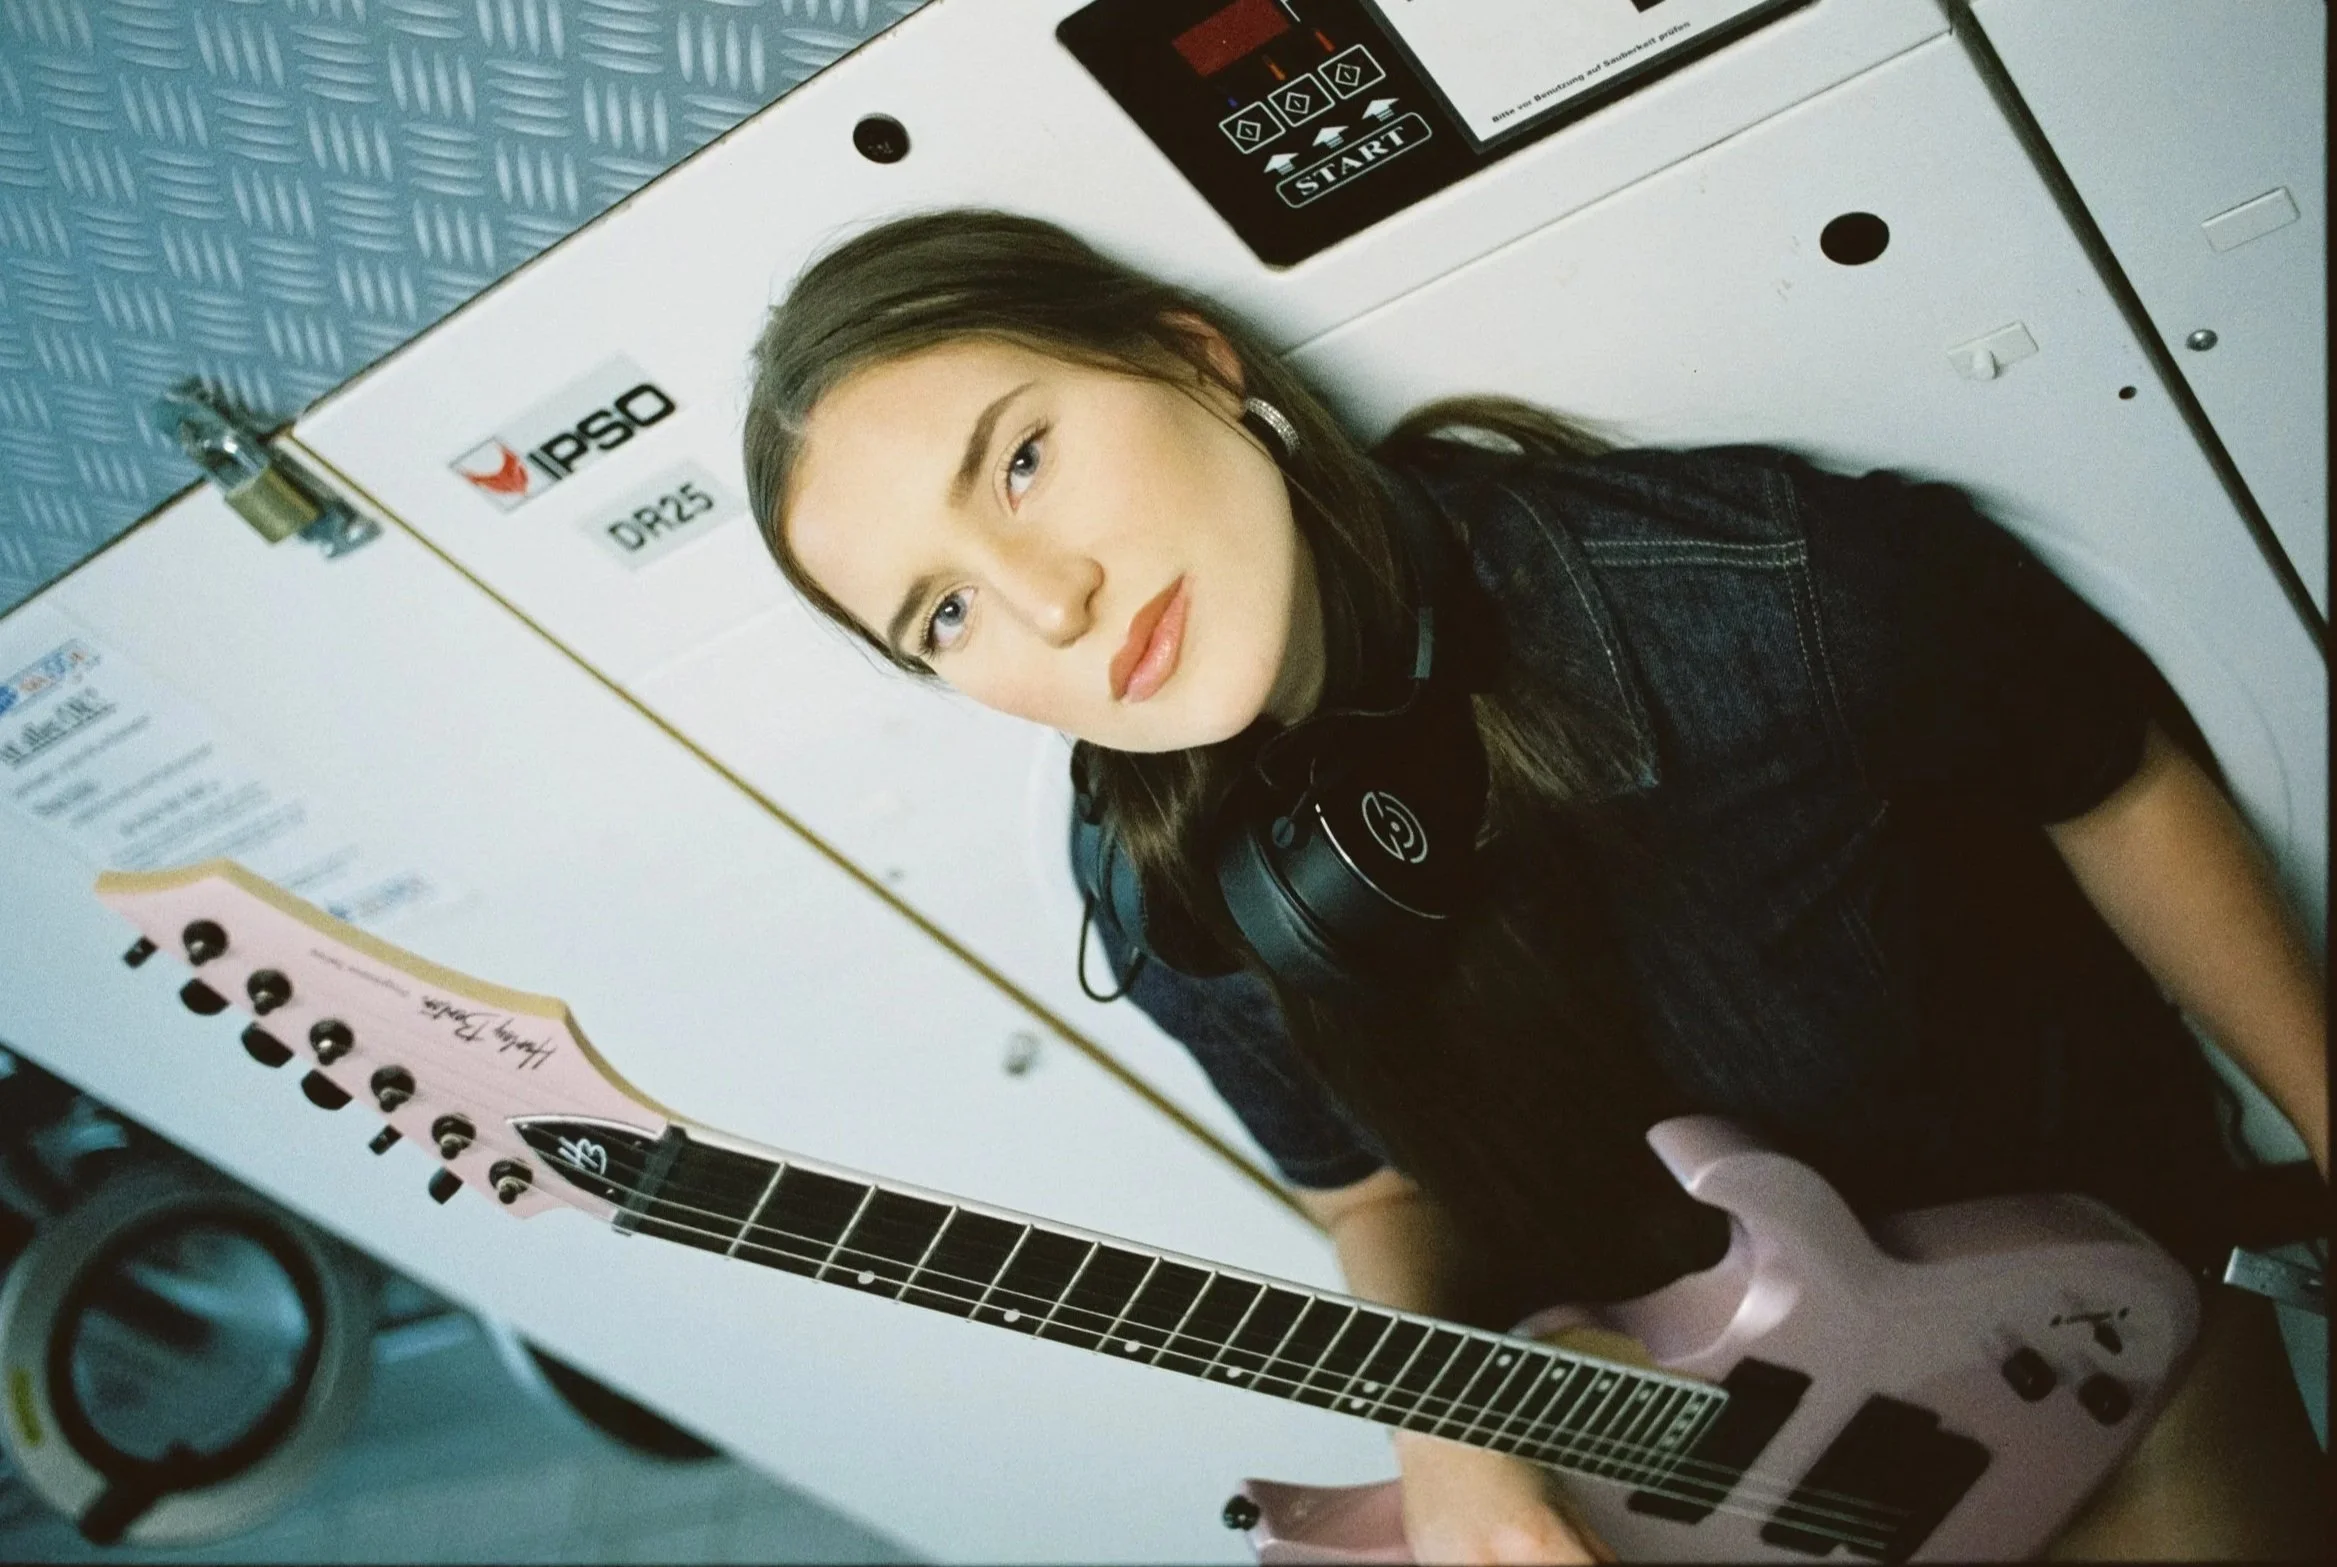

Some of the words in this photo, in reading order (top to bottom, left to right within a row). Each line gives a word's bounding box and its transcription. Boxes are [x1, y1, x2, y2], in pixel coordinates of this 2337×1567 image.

[1491, 108, 1515, 123] Bitte
[1517, 99, 1533, 111] vor
[1533, 73, 1585, 103] Benutzung
[1586, 63, 1602, 77] auf
[1602, 37, 1658, 68] Sauberkeit
[1658, 20, 1691, 42] prüfen
[1294, 125, 1405, 197] START
[528, 383, 677, 481] IPSO
[607, 482, 715, 552] DR25
[419, 996, 502, 1042] Benton
[492, 1017, 557, 1070] Harley
